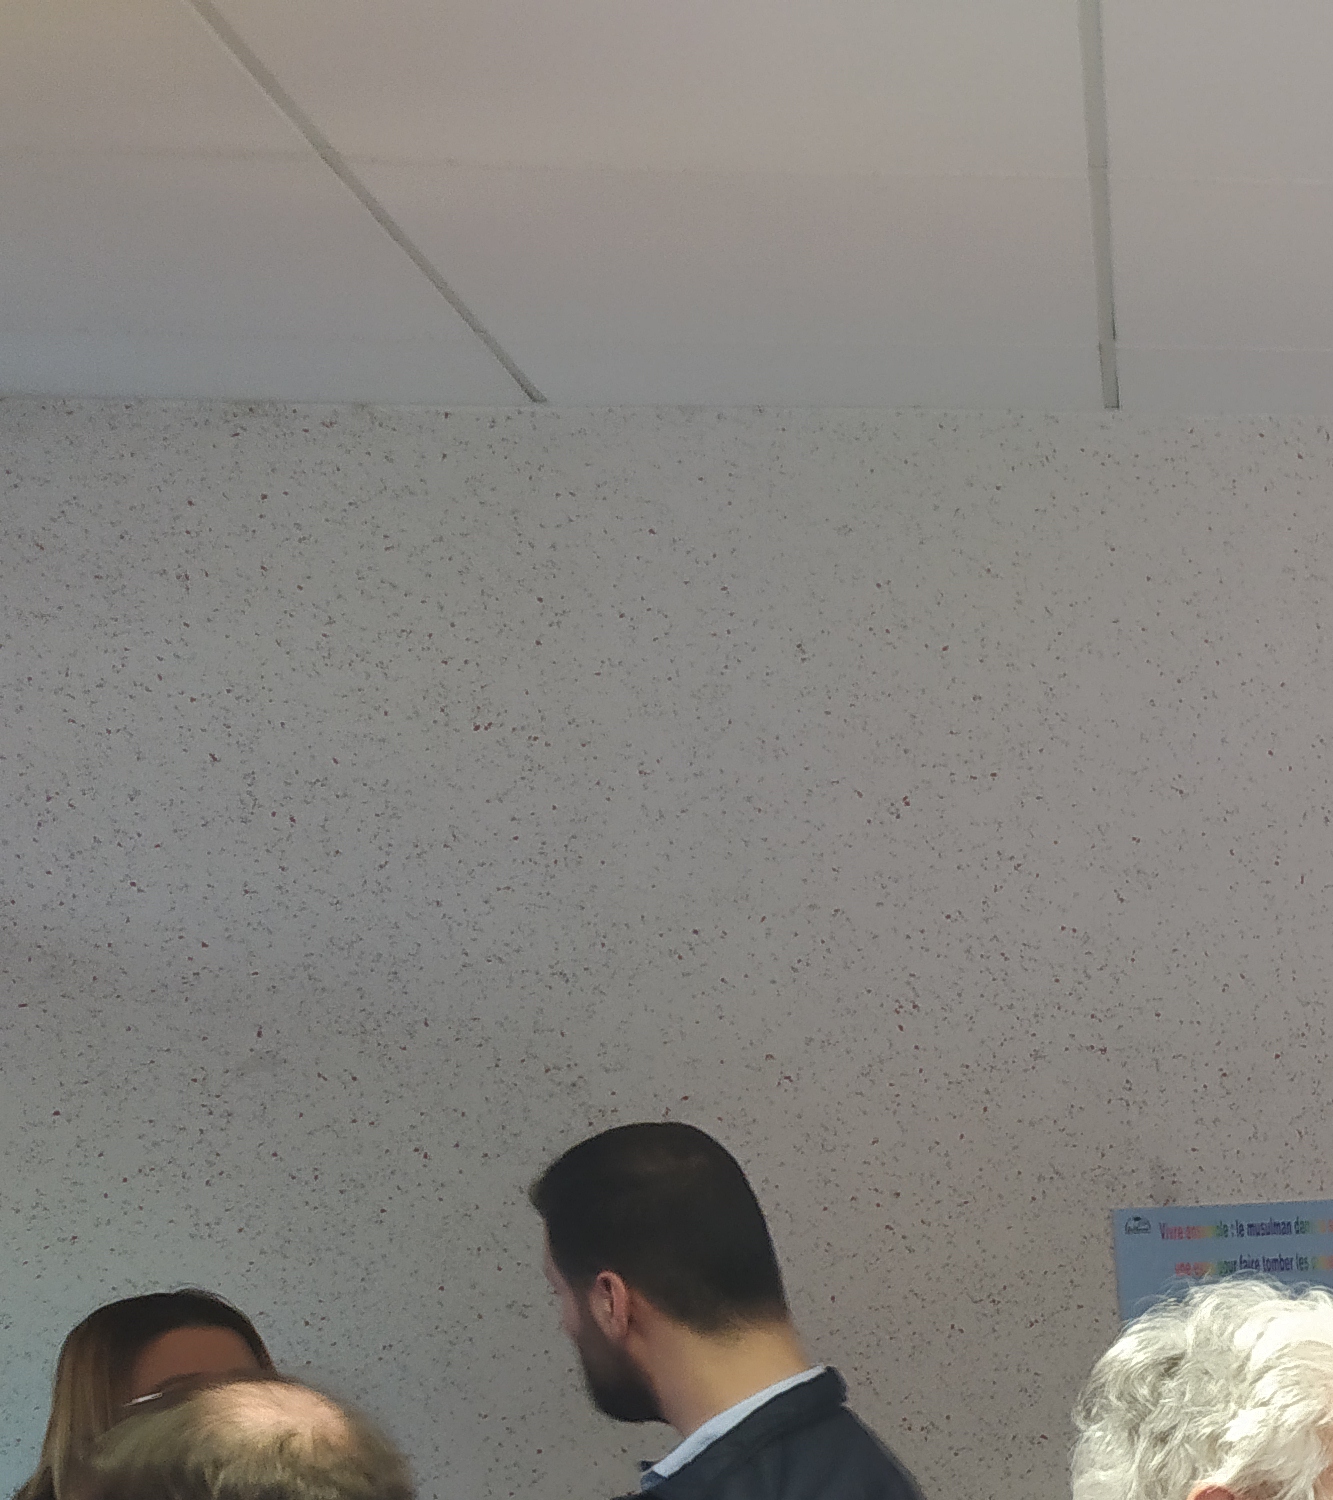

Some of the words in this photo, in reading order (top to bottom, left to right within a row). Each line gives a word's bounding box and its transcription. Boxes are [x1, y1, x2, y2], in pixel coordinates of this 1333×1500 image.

[1159, 1221, 1184, 1240] Vivre
[1235, 1219, 1245, 1238] le
[1247, 1217, 1292, 1237] musulman
[1240, 1253, 1260, 1271] faire
[1262, 1253, 1294, 1272] tomber
[1296, 1252, 1309, 1271] les
